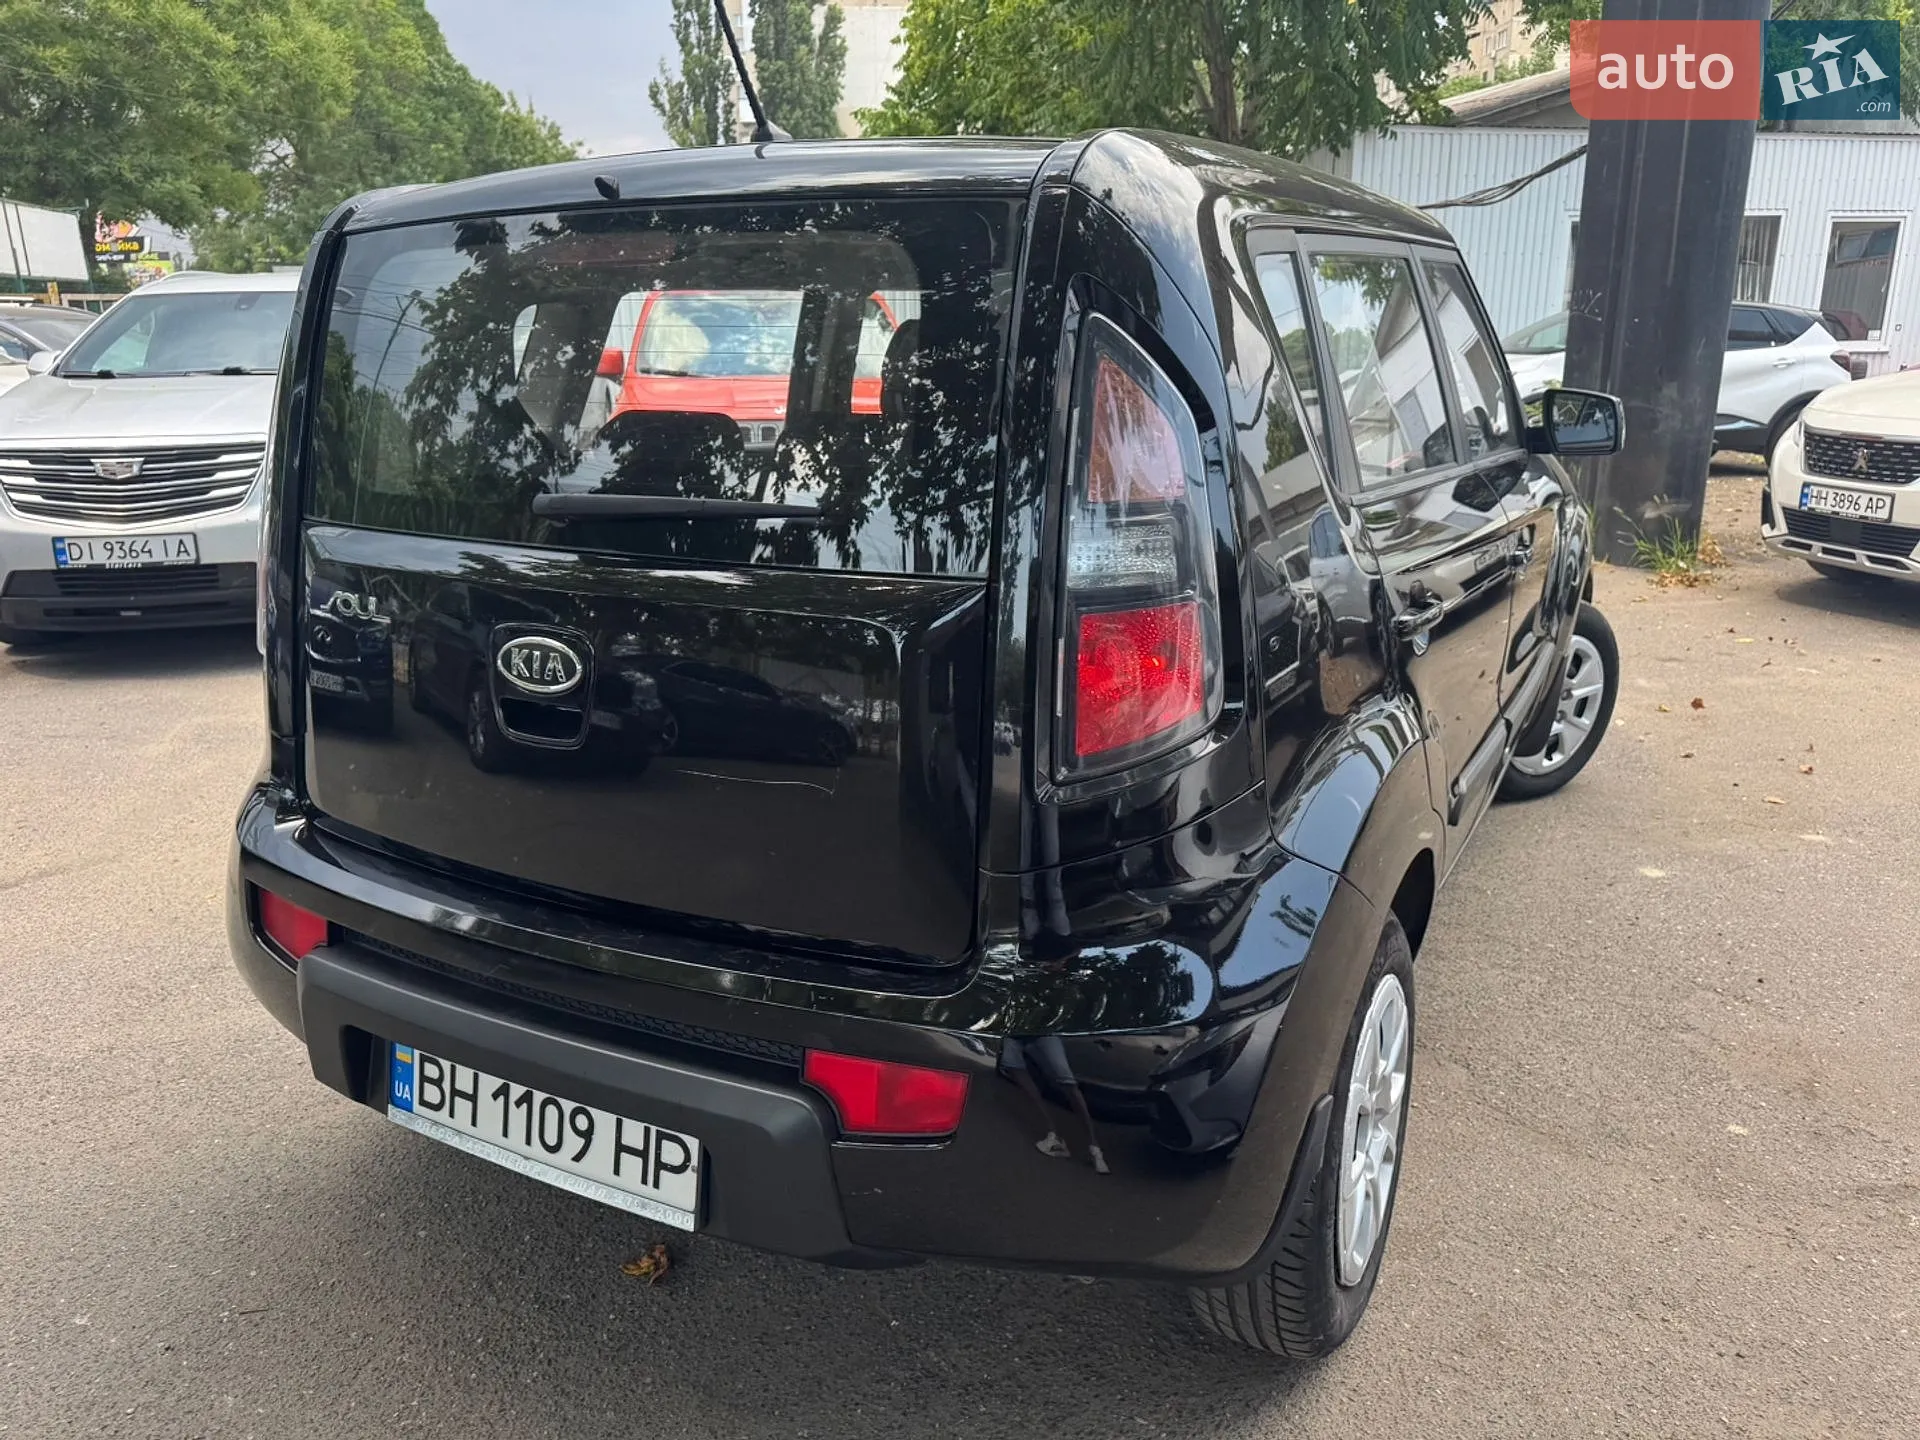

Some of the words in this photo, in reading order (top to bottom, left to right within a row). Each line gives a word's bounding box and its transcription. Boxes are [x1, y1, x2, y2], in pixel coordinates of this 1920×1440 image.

[1830, 491, 1862, 512] 3896
[1864, 496, 1887, 515] AP
[67, 541, 94, 562] DI
[103, 539, 153, 560] 9364
[162, 538, 191, 558] IA
[509, 647, 567, 683] KIA
[394, 1081, 412, 1101] UA
[418, 1051, 479, 1129] BH
[491, 1081, 595, 1164] 1109
[613, 1116, 692, 1190] HP
